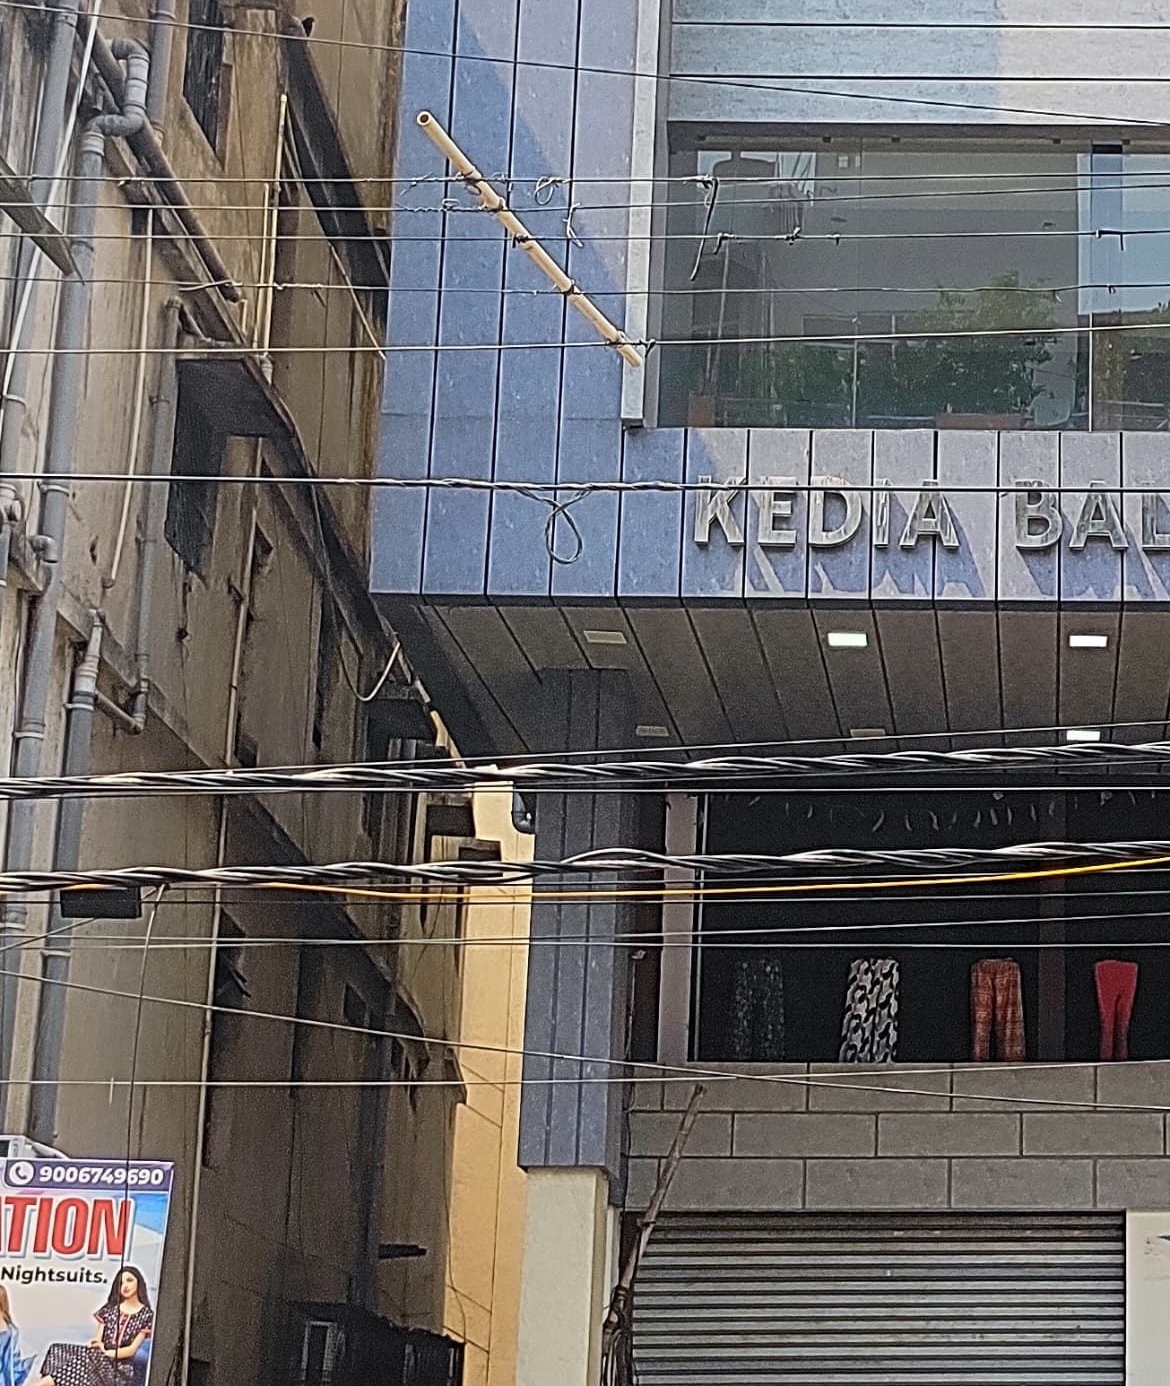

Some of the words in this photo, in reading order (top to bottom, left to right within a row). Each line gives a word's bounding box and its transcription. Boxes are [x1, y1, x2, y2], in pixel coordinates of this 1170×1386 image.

[694, 475, 959, 549] KEDIA
[39, 1166, 164, 1185] 9006749690
[0, 1196, 132, 1255] TION
[1, 1265, 108, 1285] Nightsuits.
